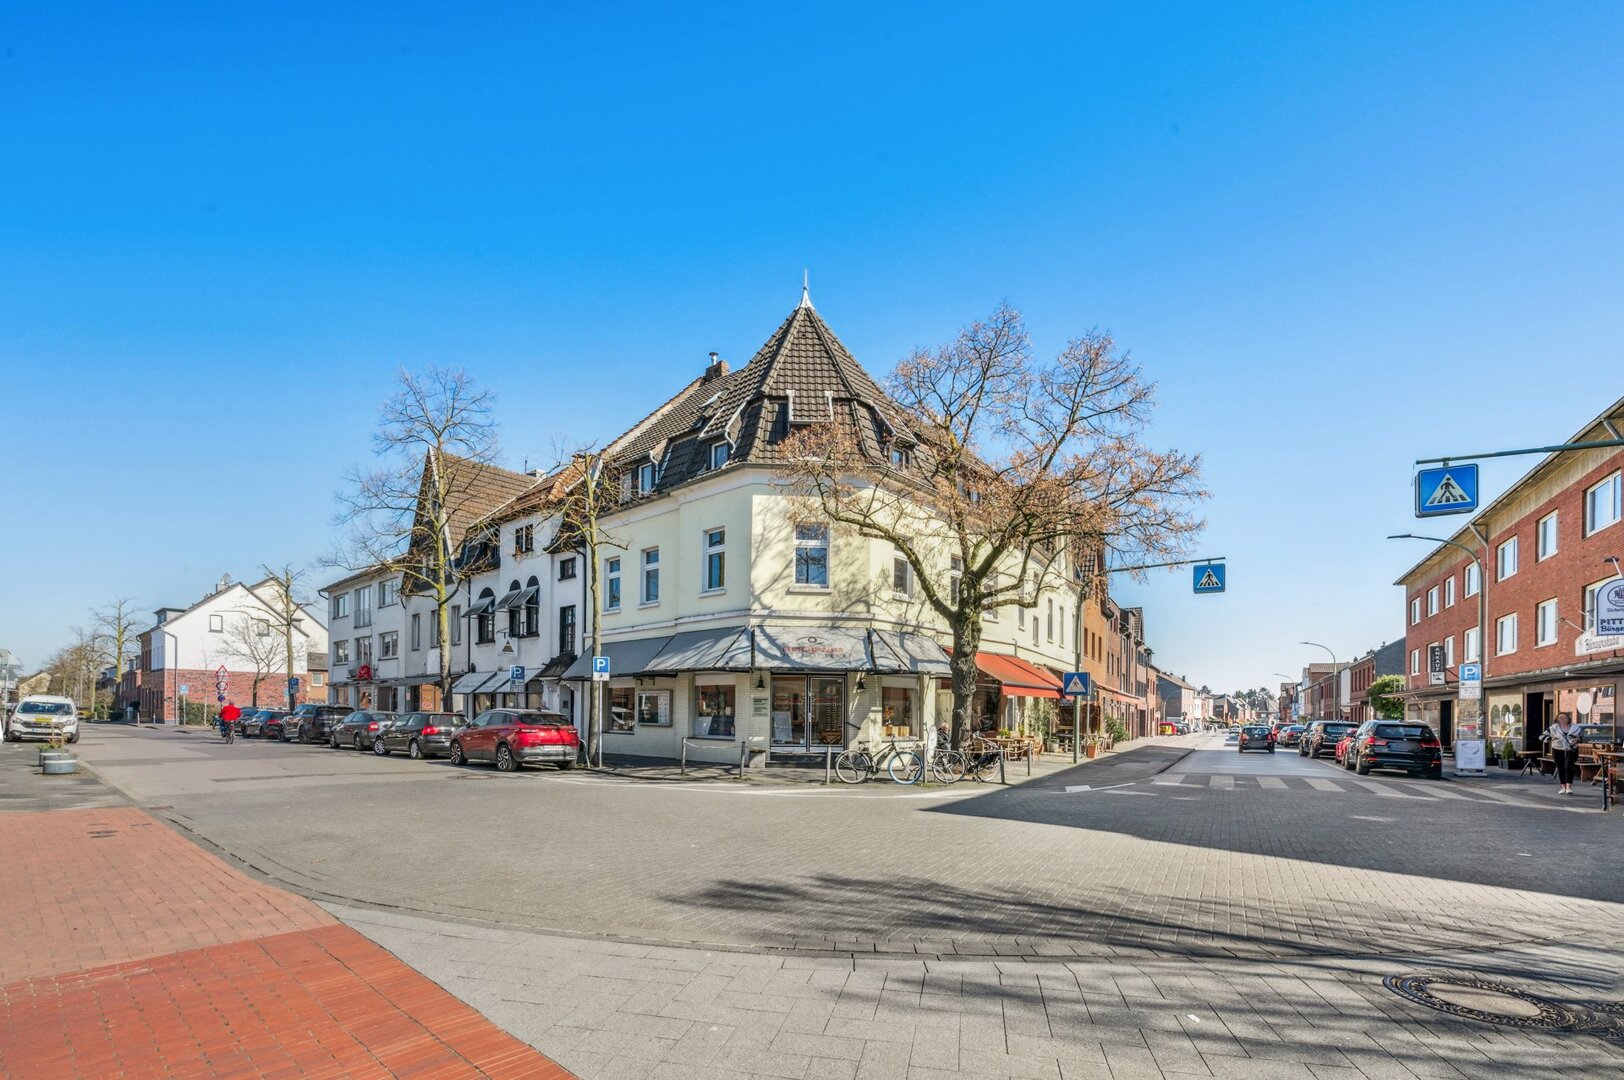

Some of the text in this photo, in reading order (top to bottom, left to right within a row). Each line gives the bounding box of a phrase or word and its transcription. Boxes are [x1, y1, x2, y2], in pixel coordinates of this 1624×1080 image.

[596, 659, 606, 671] P
[513, 667, 522, 678] P
[1464, 666, 1476, 679] P
